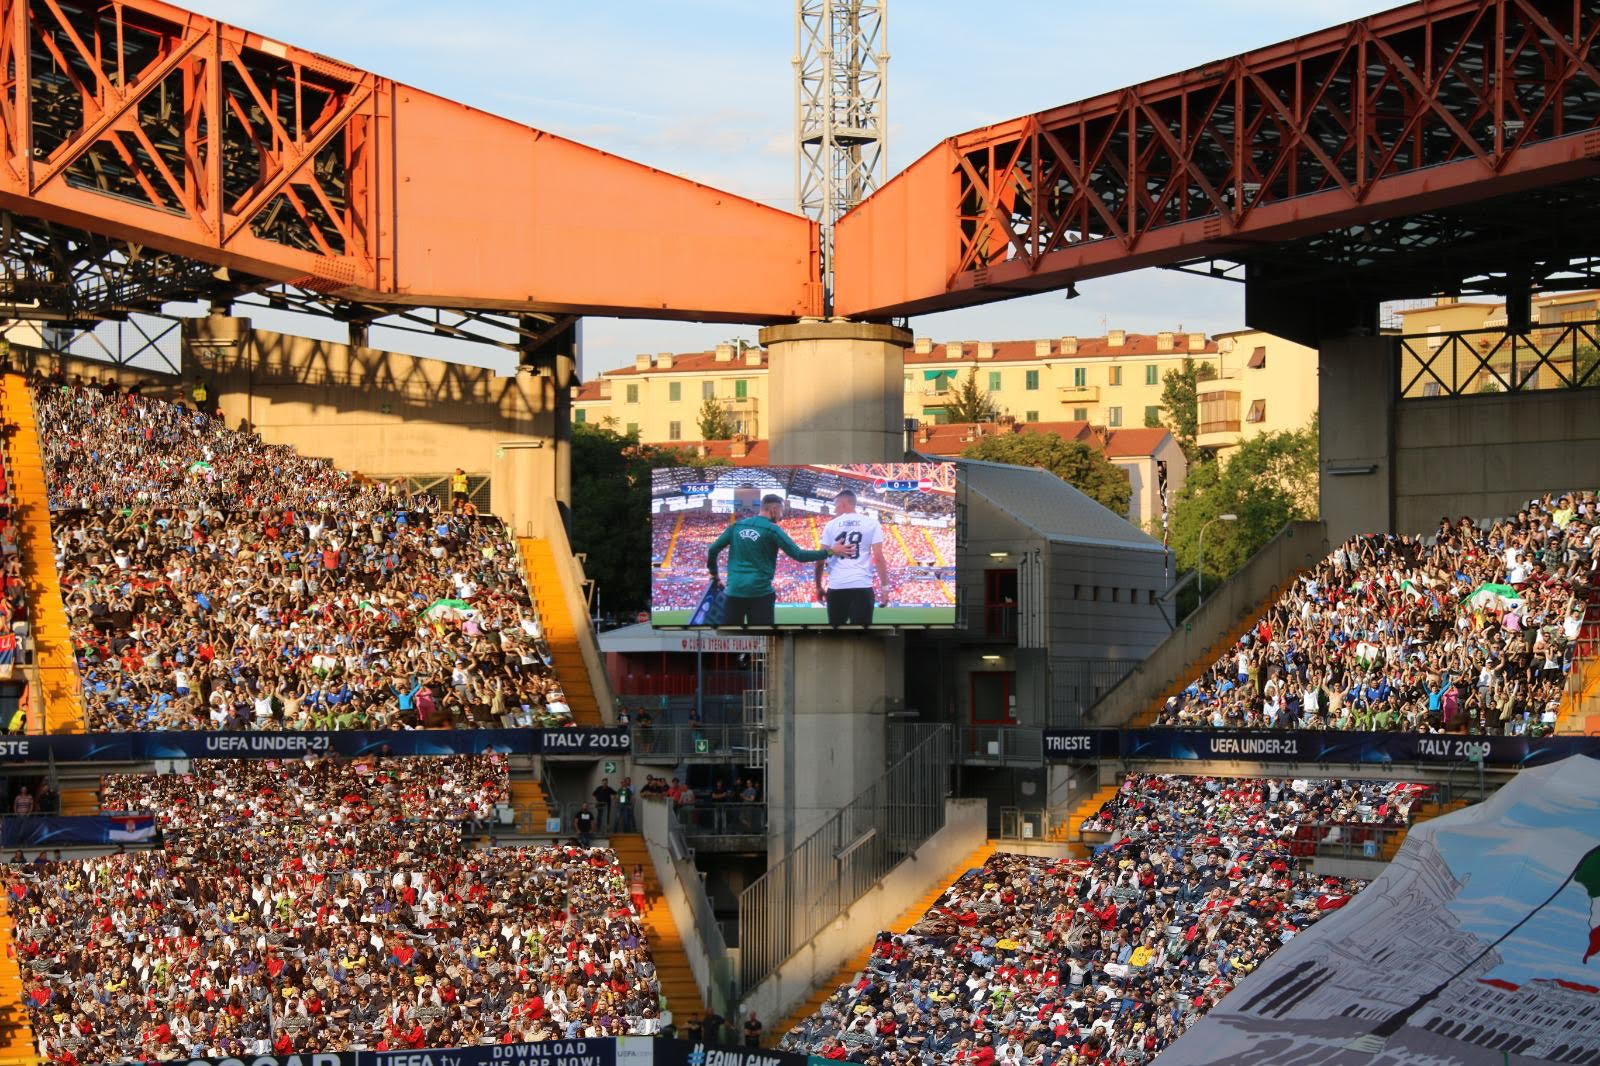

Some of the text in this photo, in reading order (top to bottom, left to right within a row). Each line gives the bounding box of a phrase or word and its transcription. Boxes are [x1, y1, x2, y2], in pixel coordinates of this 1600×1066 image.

[206, 736, 330, 750] UEFA UNDER-21
[543, 733, 630, 747] ITALY 2019
[1046, 736, 1091, 750] TRIESTE
[1210, 738, 1298, 754] UEFA UNDER-21
[0, 741, 29, 755] STE
[1417, 739, 1452, 756] TALY
[493, 1042, 587, 1058] DOWNLOAD
[557, 1056, 601, 1066] NOW!
